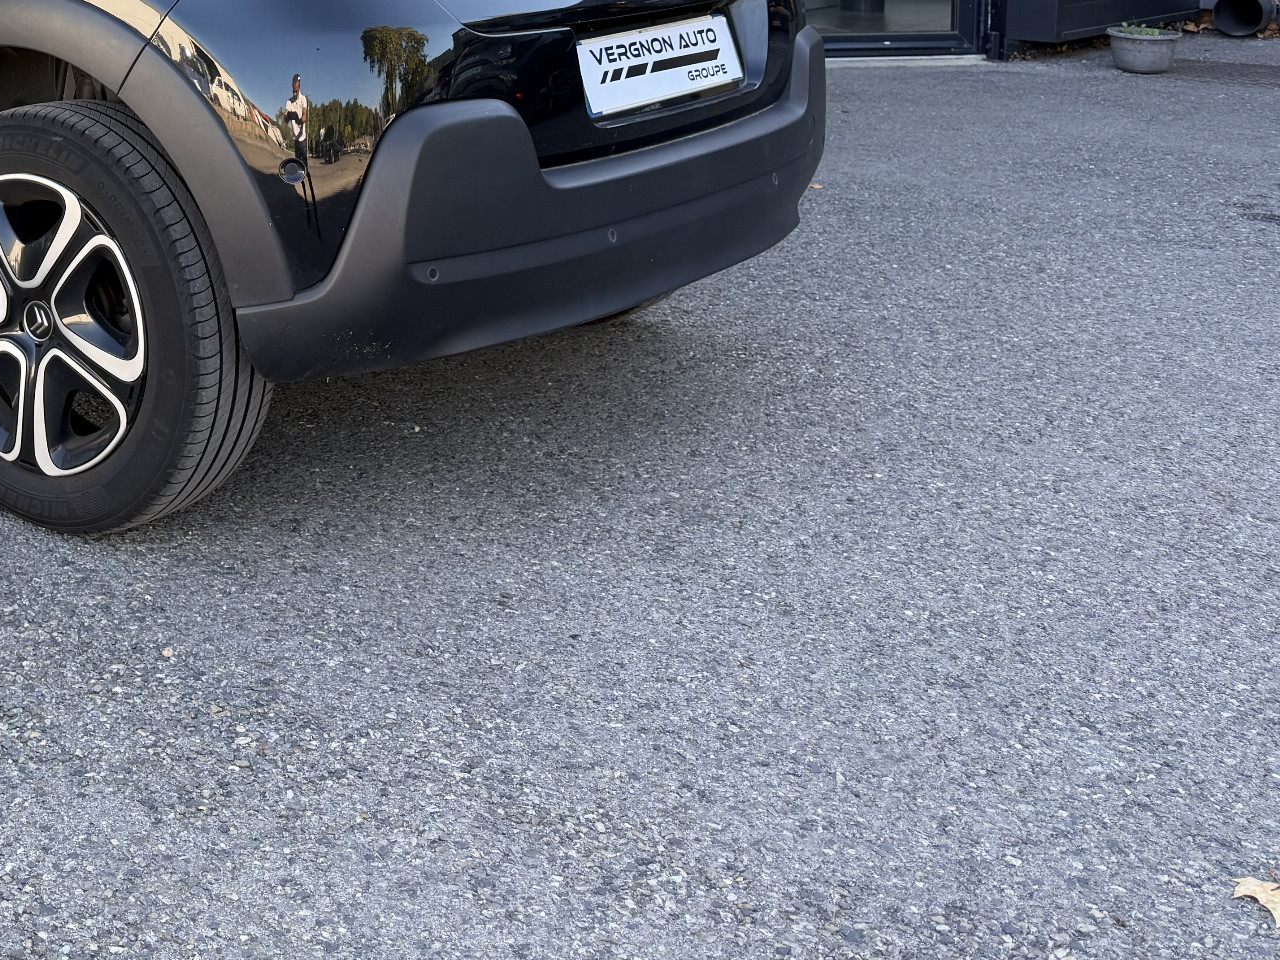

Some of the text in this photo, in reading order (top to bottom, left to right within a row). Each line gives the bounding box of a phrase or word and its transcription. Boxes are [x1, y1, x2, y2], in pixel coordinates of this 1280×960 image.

[589, 28, 717, 65] VERGNON AUTO
[688, 64, 727, 81] GROUPE
